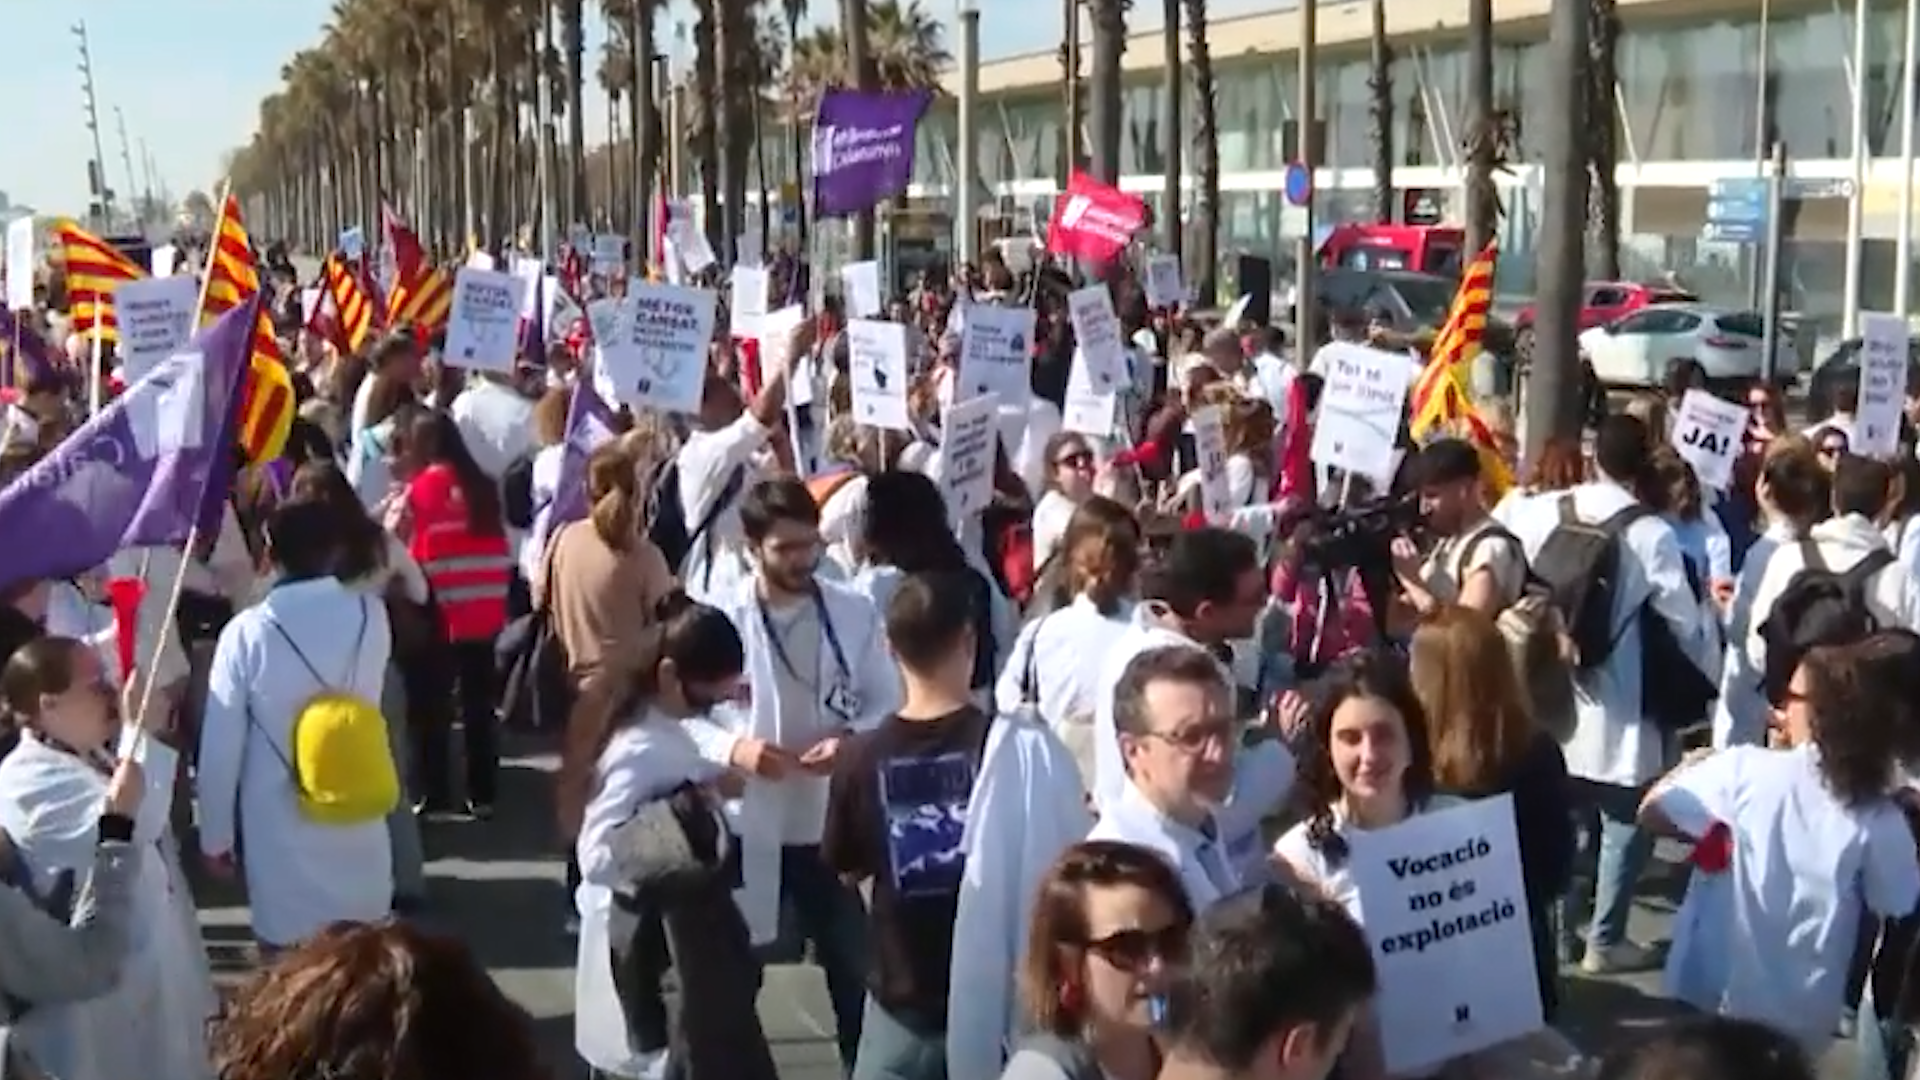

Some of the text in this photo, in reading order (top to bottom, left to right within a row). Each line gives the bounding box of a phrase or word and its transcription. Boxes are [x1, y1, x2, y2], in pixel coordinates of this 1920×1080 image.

[1683, 427, 1729, 456] JA!
[1387, 836, 1491, 879] Vocació
[1408, 889, 1443, 912] no
[1381, 899, 1516, 953] explotació
